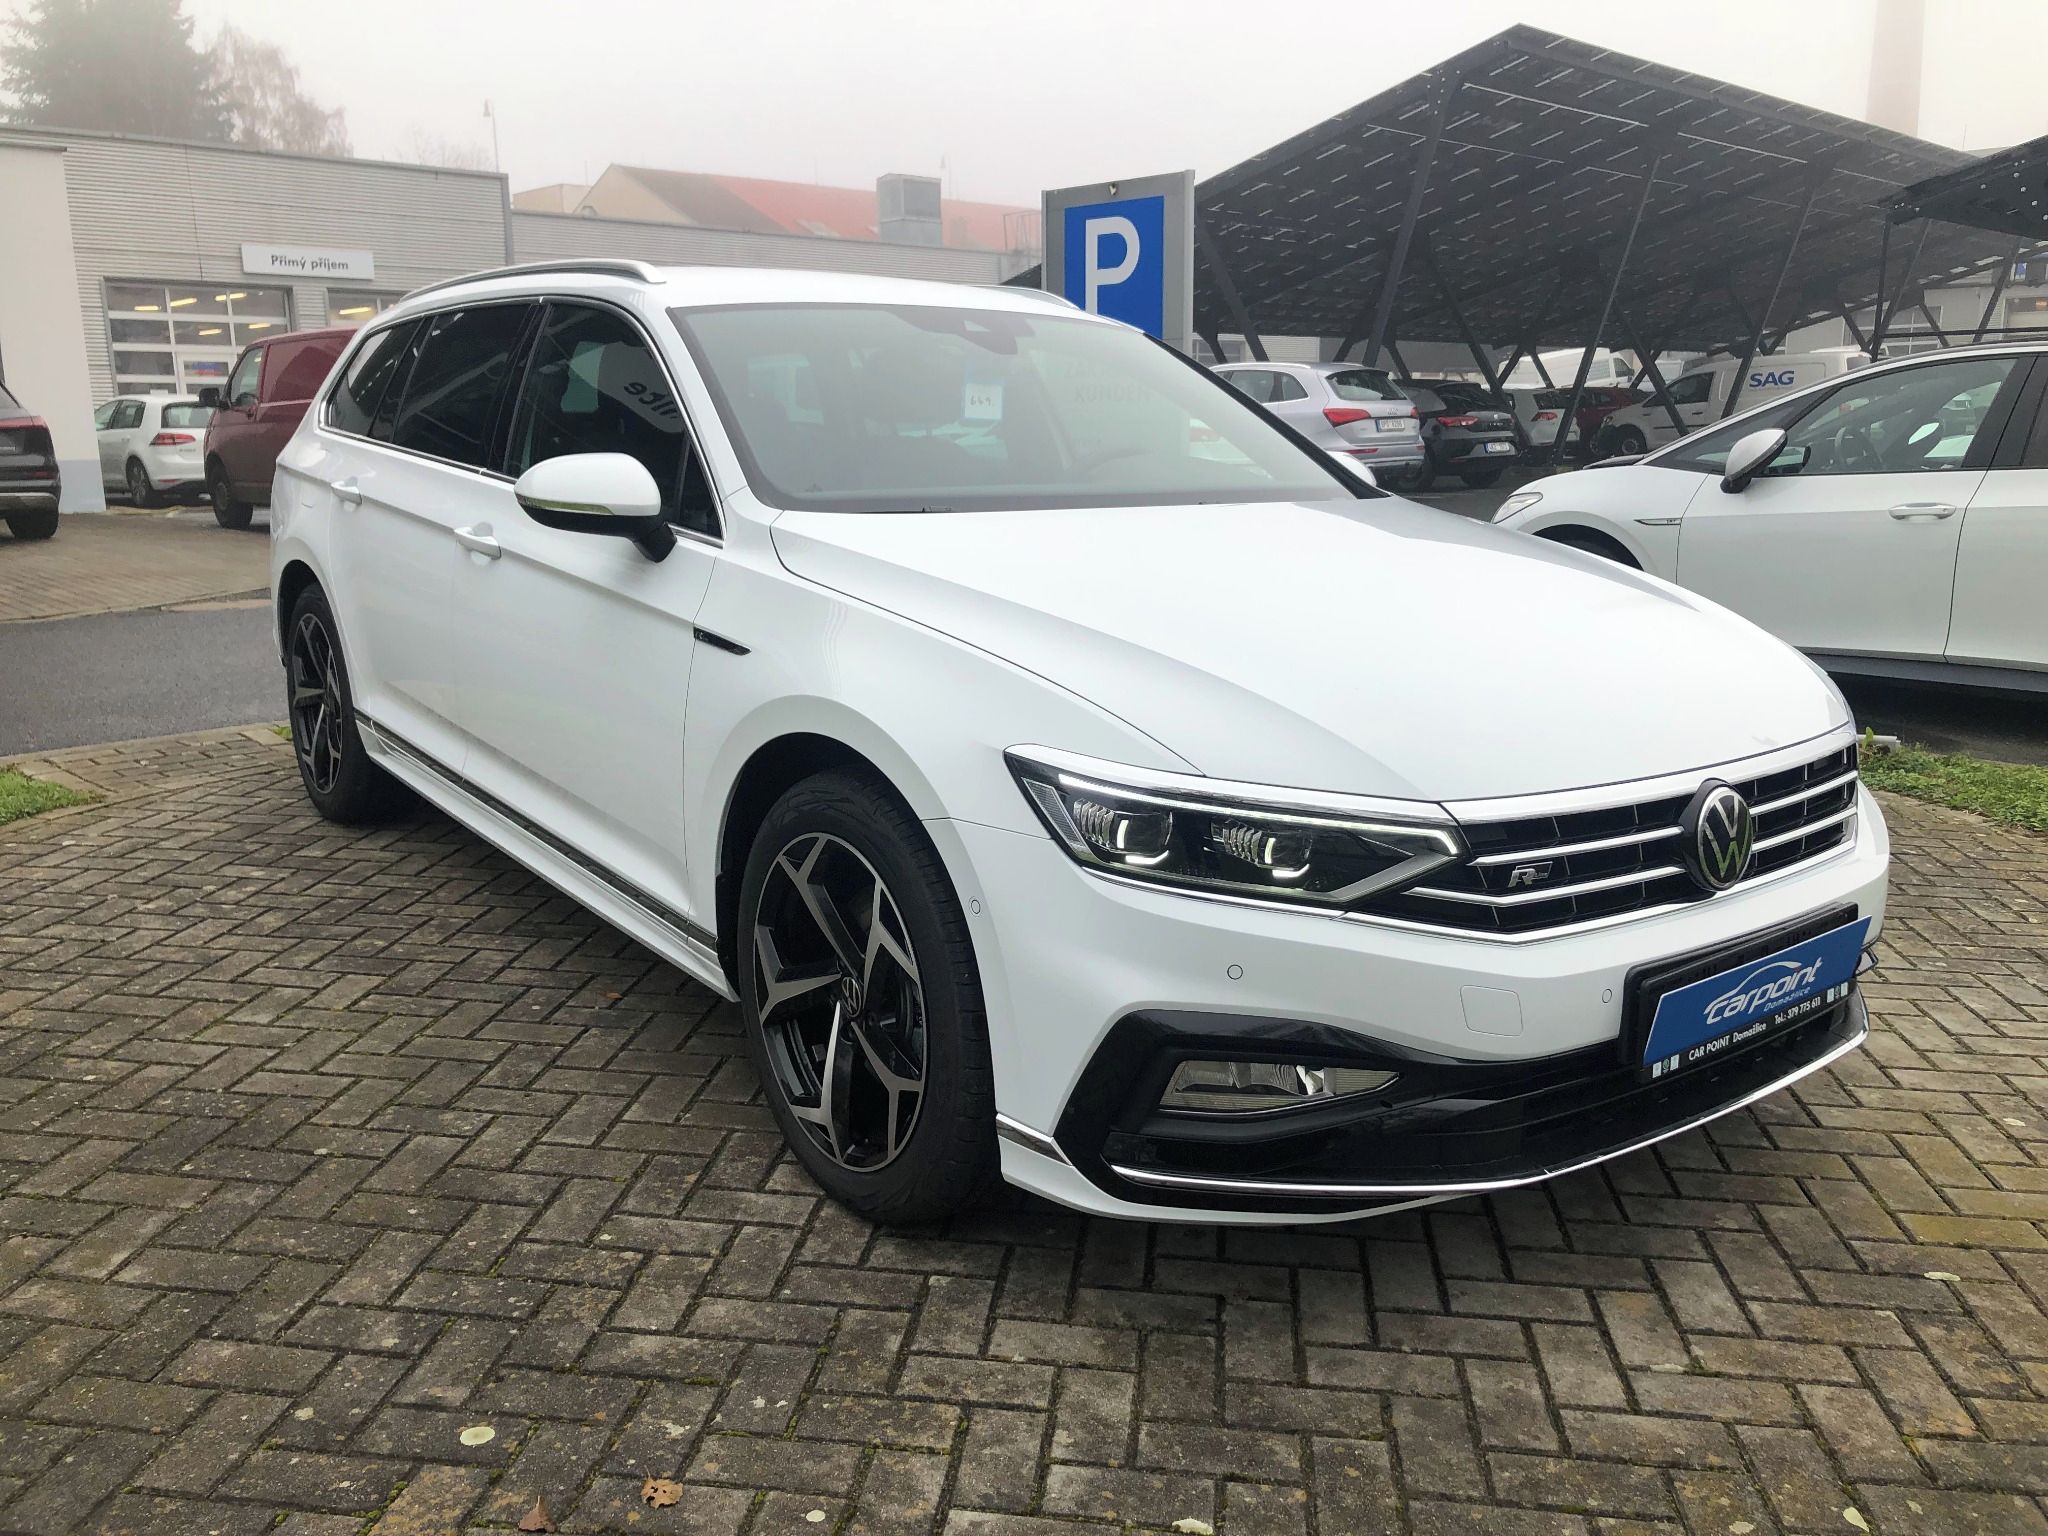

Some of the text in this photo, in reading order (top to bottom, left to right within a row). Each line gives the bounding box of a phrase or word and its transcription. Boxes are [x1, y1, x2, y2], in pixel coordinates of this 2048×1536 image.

[1085, 216, 1140, 315] P
[1749, 370, 1795, 387] SAG
[1704, 957, 1822, 1025] carpoint
[1688, 1045, 1705, 1061] CAR
[1706, 1035, 1731, 1054] POINT
[1787, 1006, 1799, 1019] 379
[1800, 1000, 1811, 1014] 775
[1811, 996, 1821, 1010] 611
